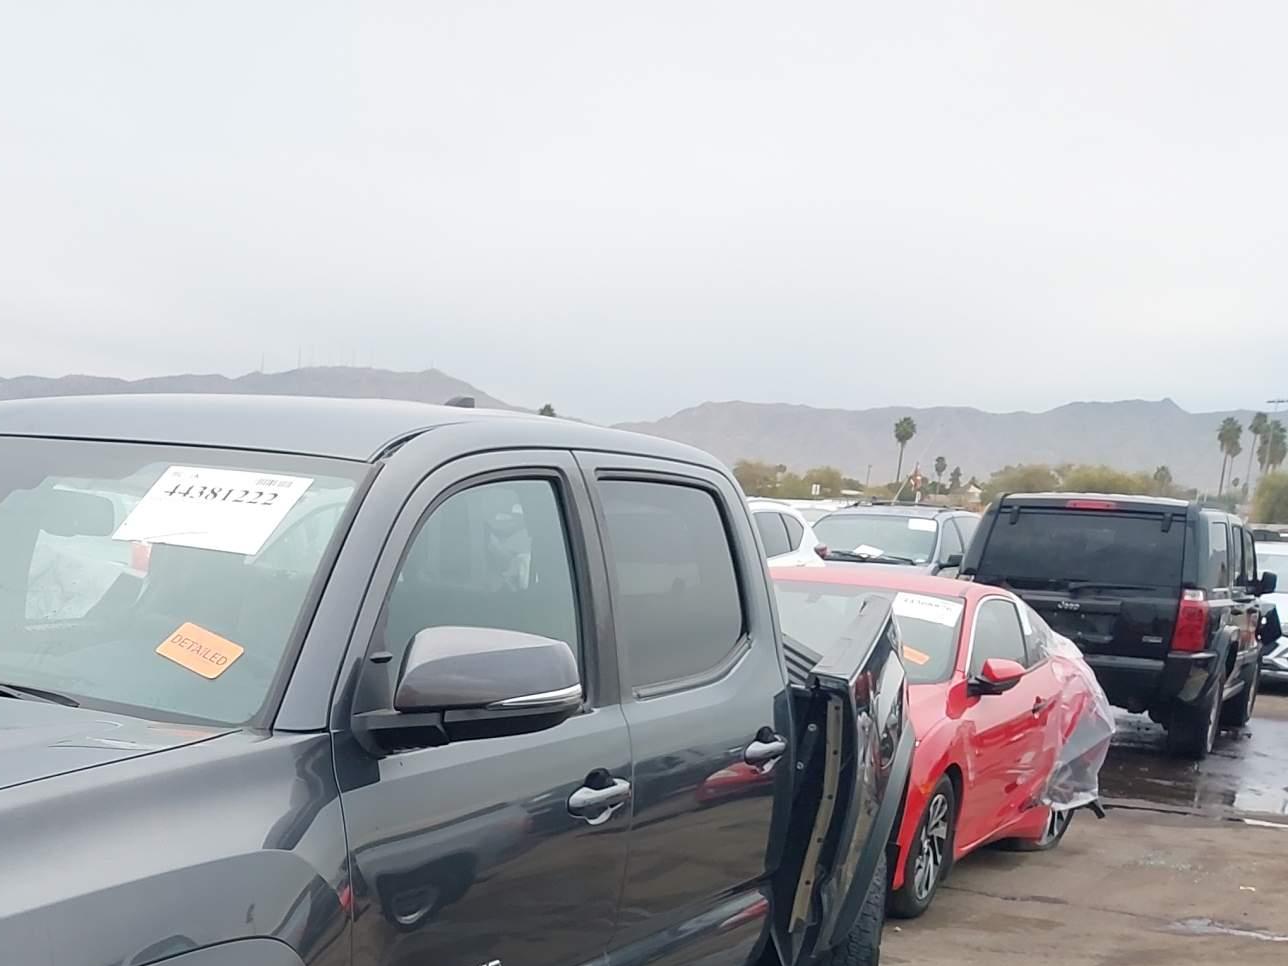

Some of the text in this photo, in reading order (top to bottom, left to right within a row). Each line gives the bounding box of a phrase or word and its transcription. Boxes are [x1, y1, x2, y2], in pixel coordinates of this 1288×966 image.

[164, 483, 279, 506] 44381222
[1057, 600, 1081, 611] Jeep
[170, 633, 228, 666] DETAILED
